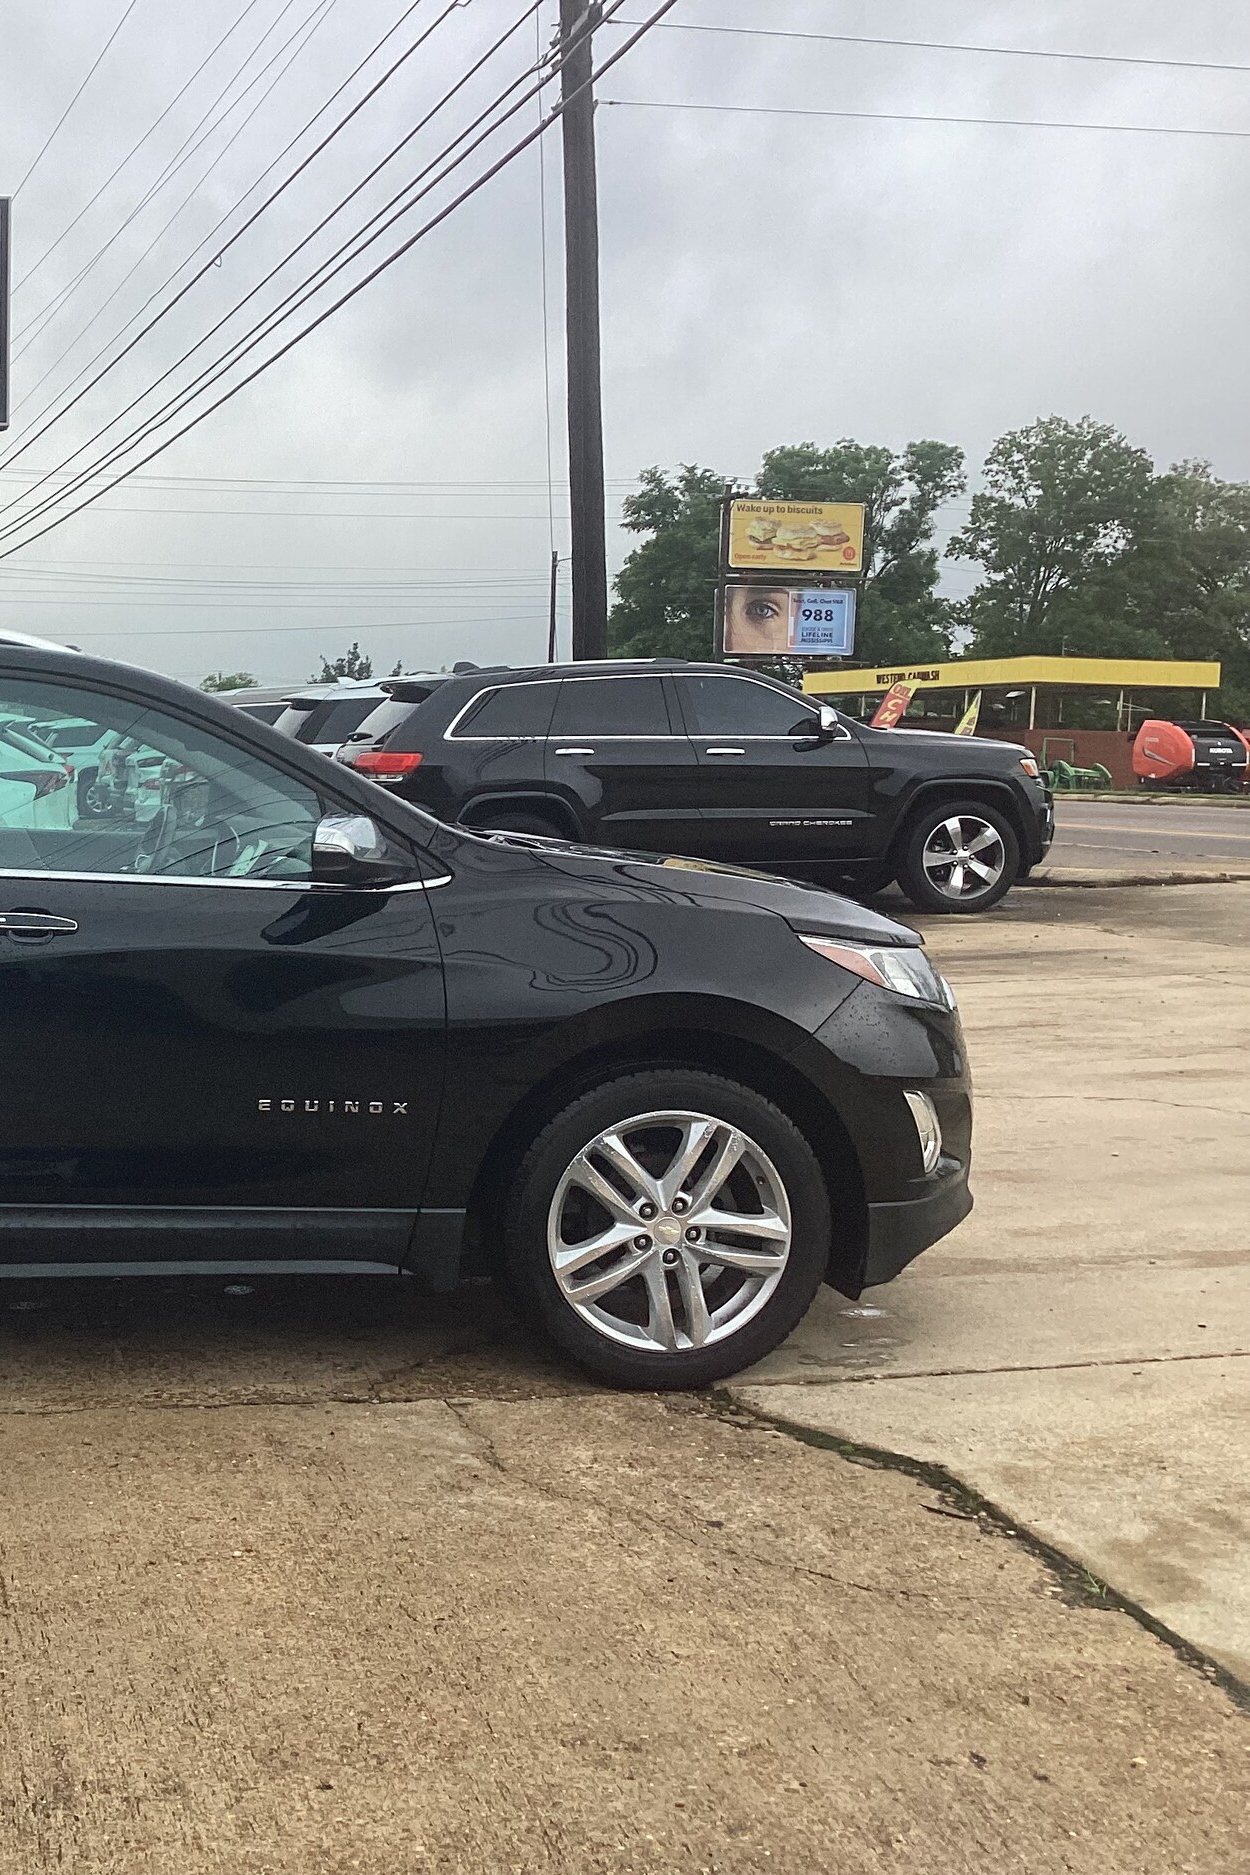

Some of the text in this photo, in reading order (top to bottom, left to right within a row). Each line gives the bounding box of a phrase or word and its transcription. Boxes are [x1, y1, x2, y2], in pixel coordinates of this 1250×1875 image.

[737, 504, 823, 515] Wake up to biscuits
[802, 609, 834, 622] 988
[893, 684, 911, 698] OIL
[258, 1100, 408, 1114] EQUINOX
